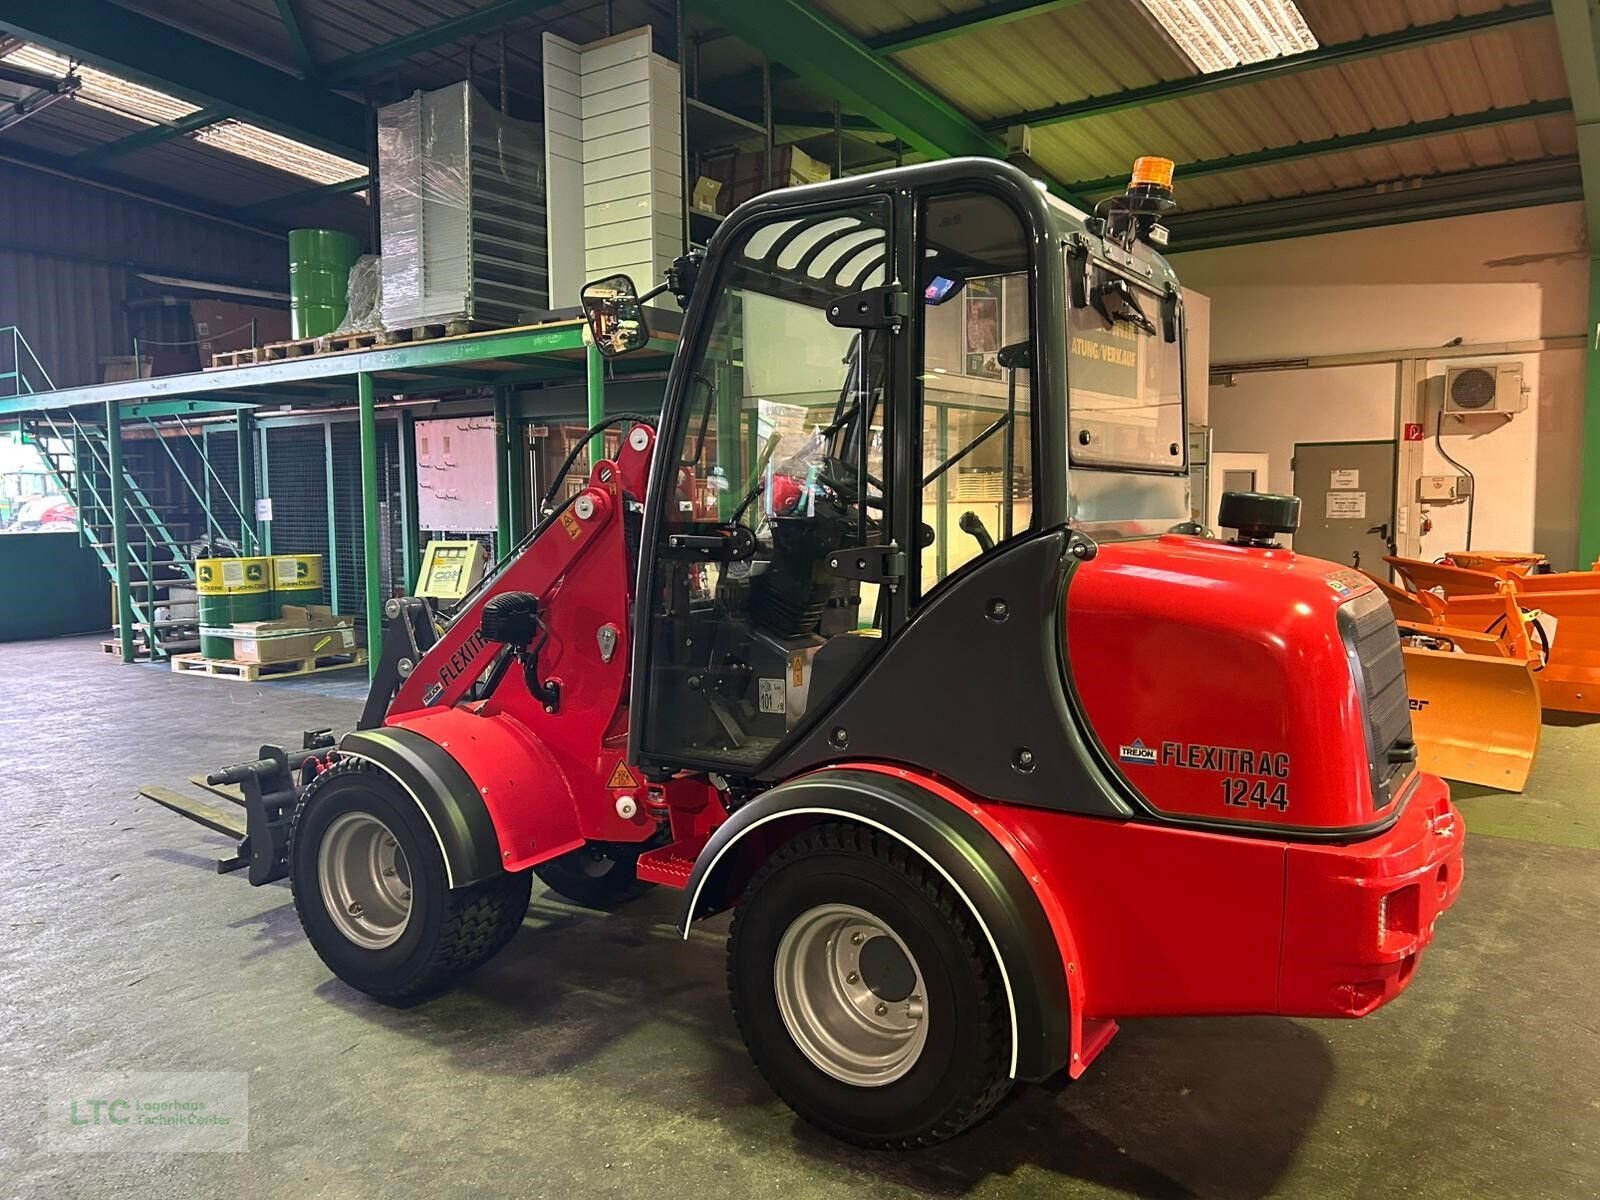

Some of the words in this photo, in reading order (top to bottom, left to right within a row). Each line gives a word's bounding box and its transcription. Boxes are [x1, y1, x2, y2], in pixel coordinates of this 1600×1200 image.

[1121, 747, 1155, 758] TREJON
[1162, 742, 1289, 778] FLEXITRAC
[1221, 777, 1289, 812] 1244
